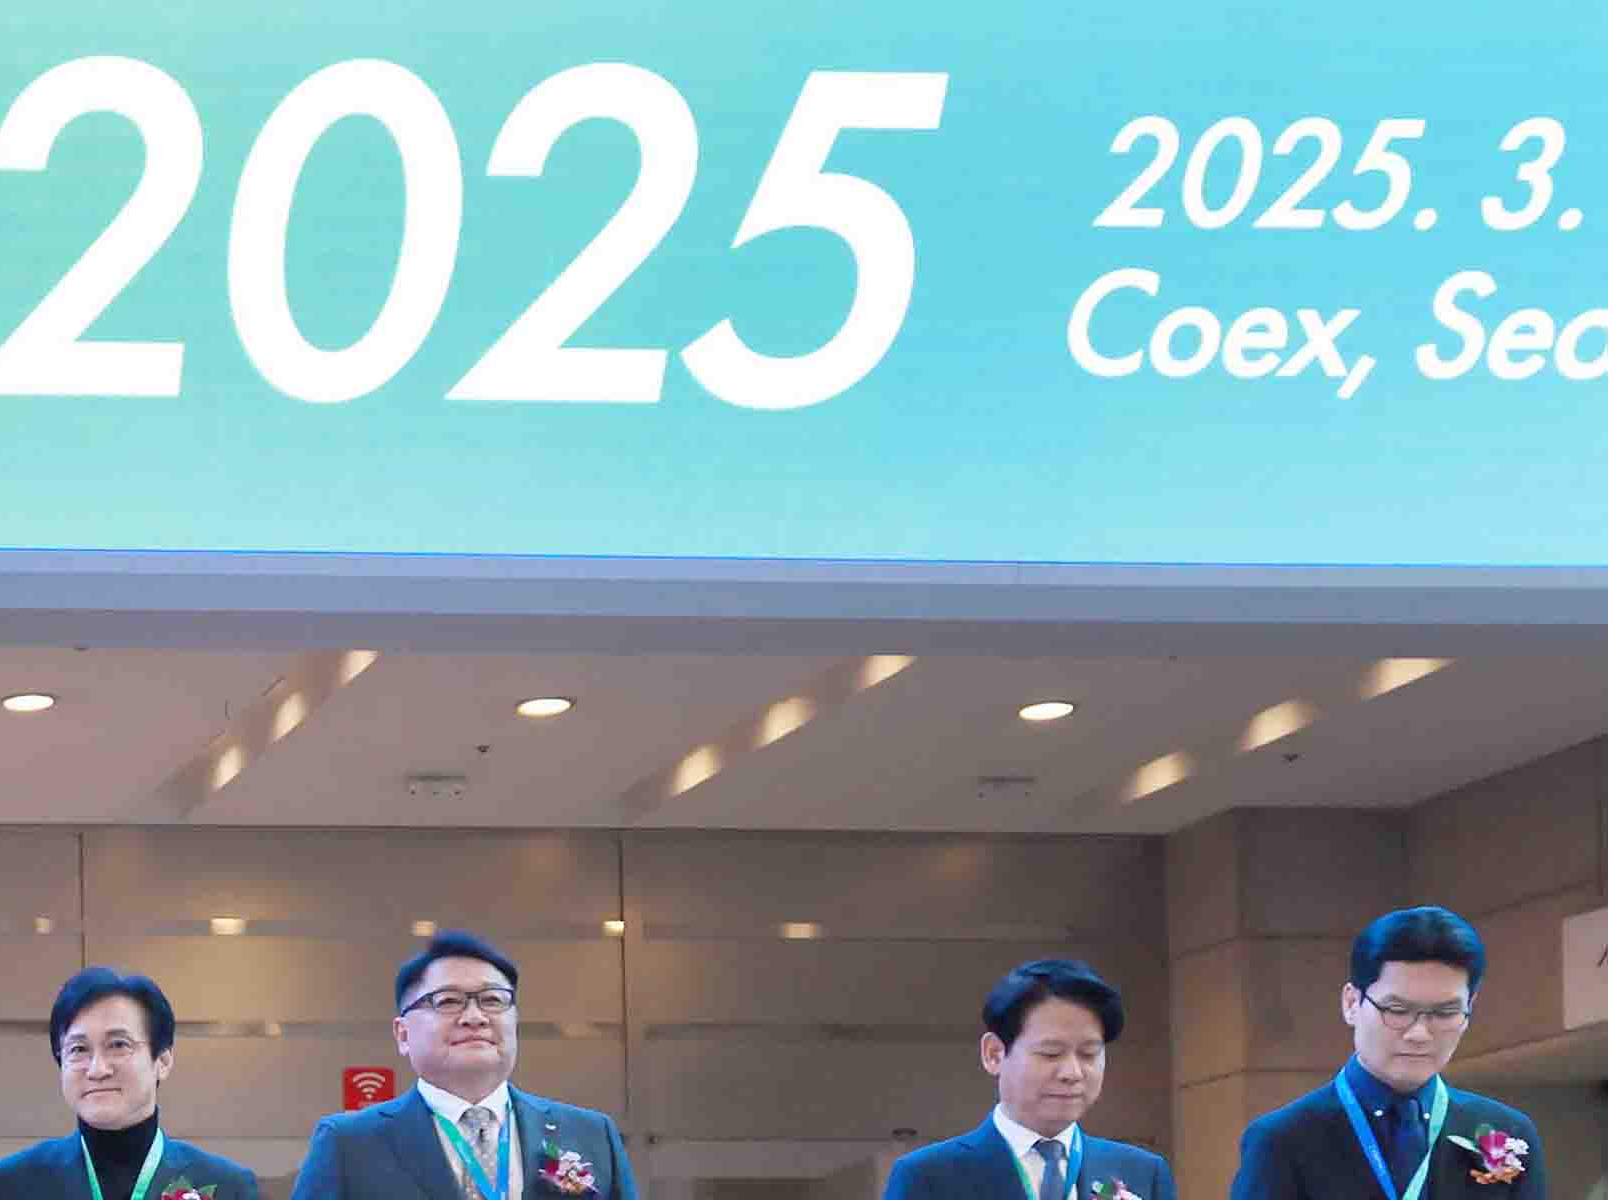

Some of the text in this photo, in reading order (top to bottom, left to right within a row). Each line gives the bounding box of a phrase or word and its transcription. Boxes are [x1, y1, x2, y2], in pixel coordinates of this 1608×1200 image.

[1091, 115, 1584, 231] 2025. 3.
[1067, 268, 1608, 400] Coex, Seo
